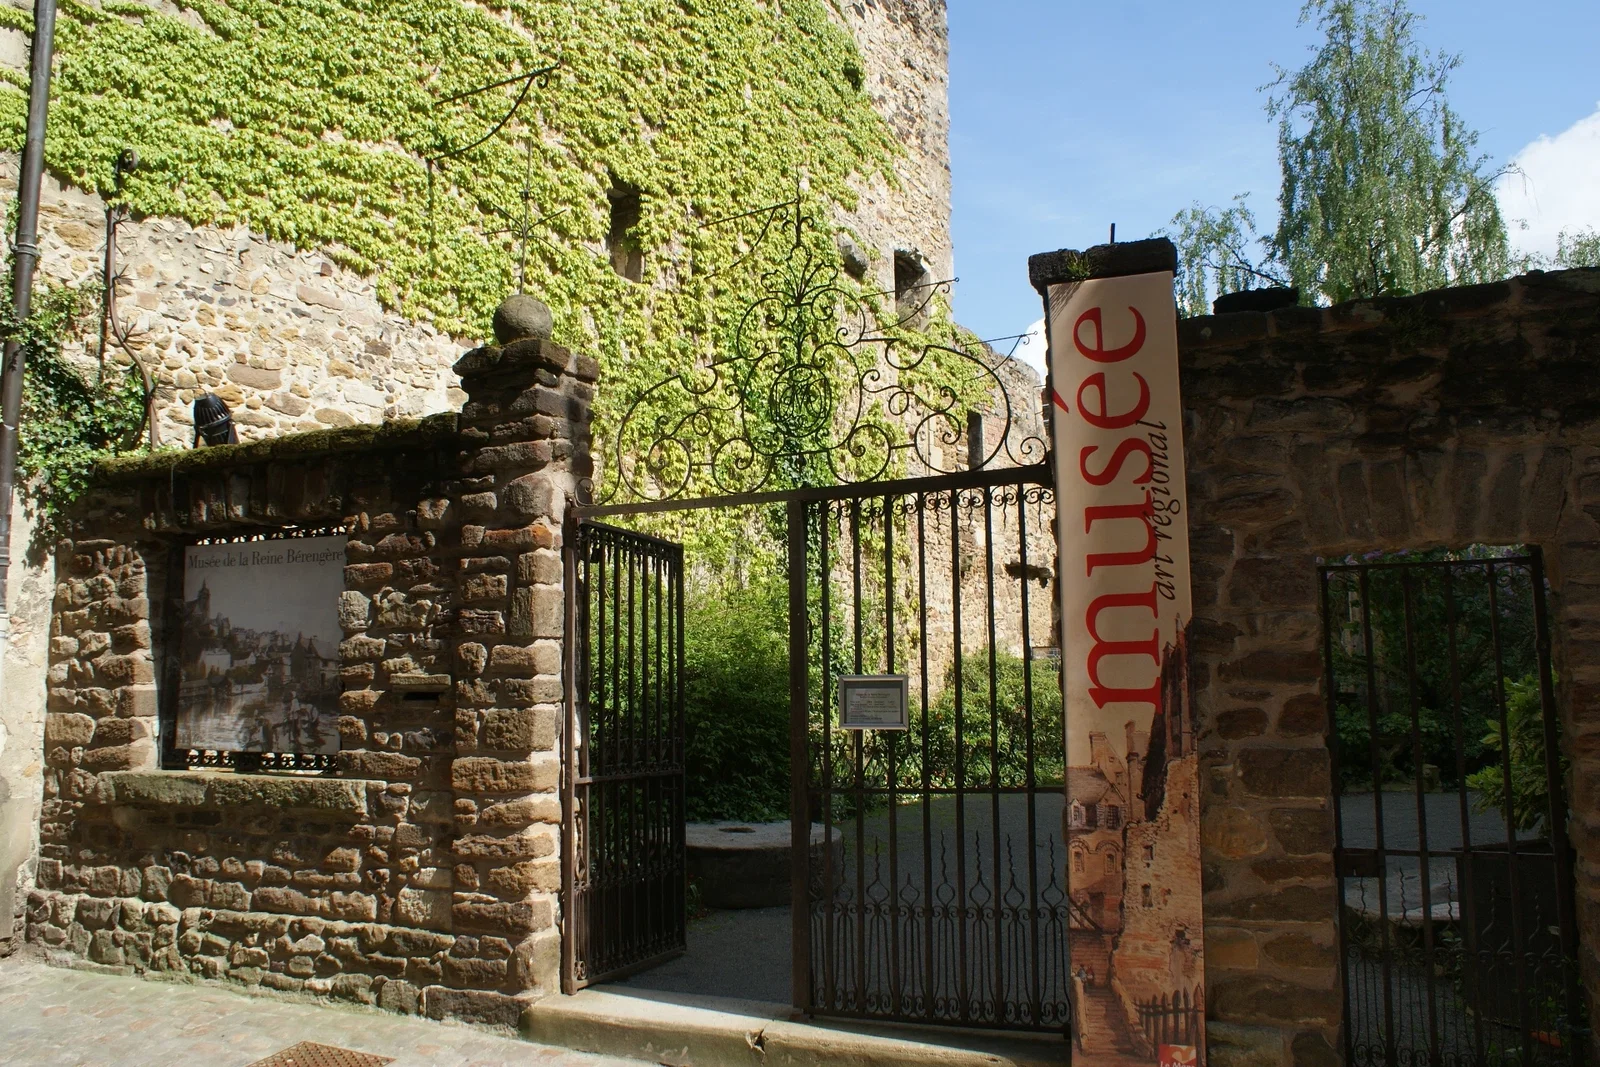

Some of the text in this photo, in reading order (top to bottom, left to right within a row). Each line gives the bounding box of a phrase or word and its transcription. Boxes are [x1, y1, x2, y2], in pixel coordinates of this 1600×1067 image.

[188, 548, 344, 569] Musée de la Reine Bérengère
[1053, 305, 1163, 715] musée
[1136, 420, 1181, 600] art régional
